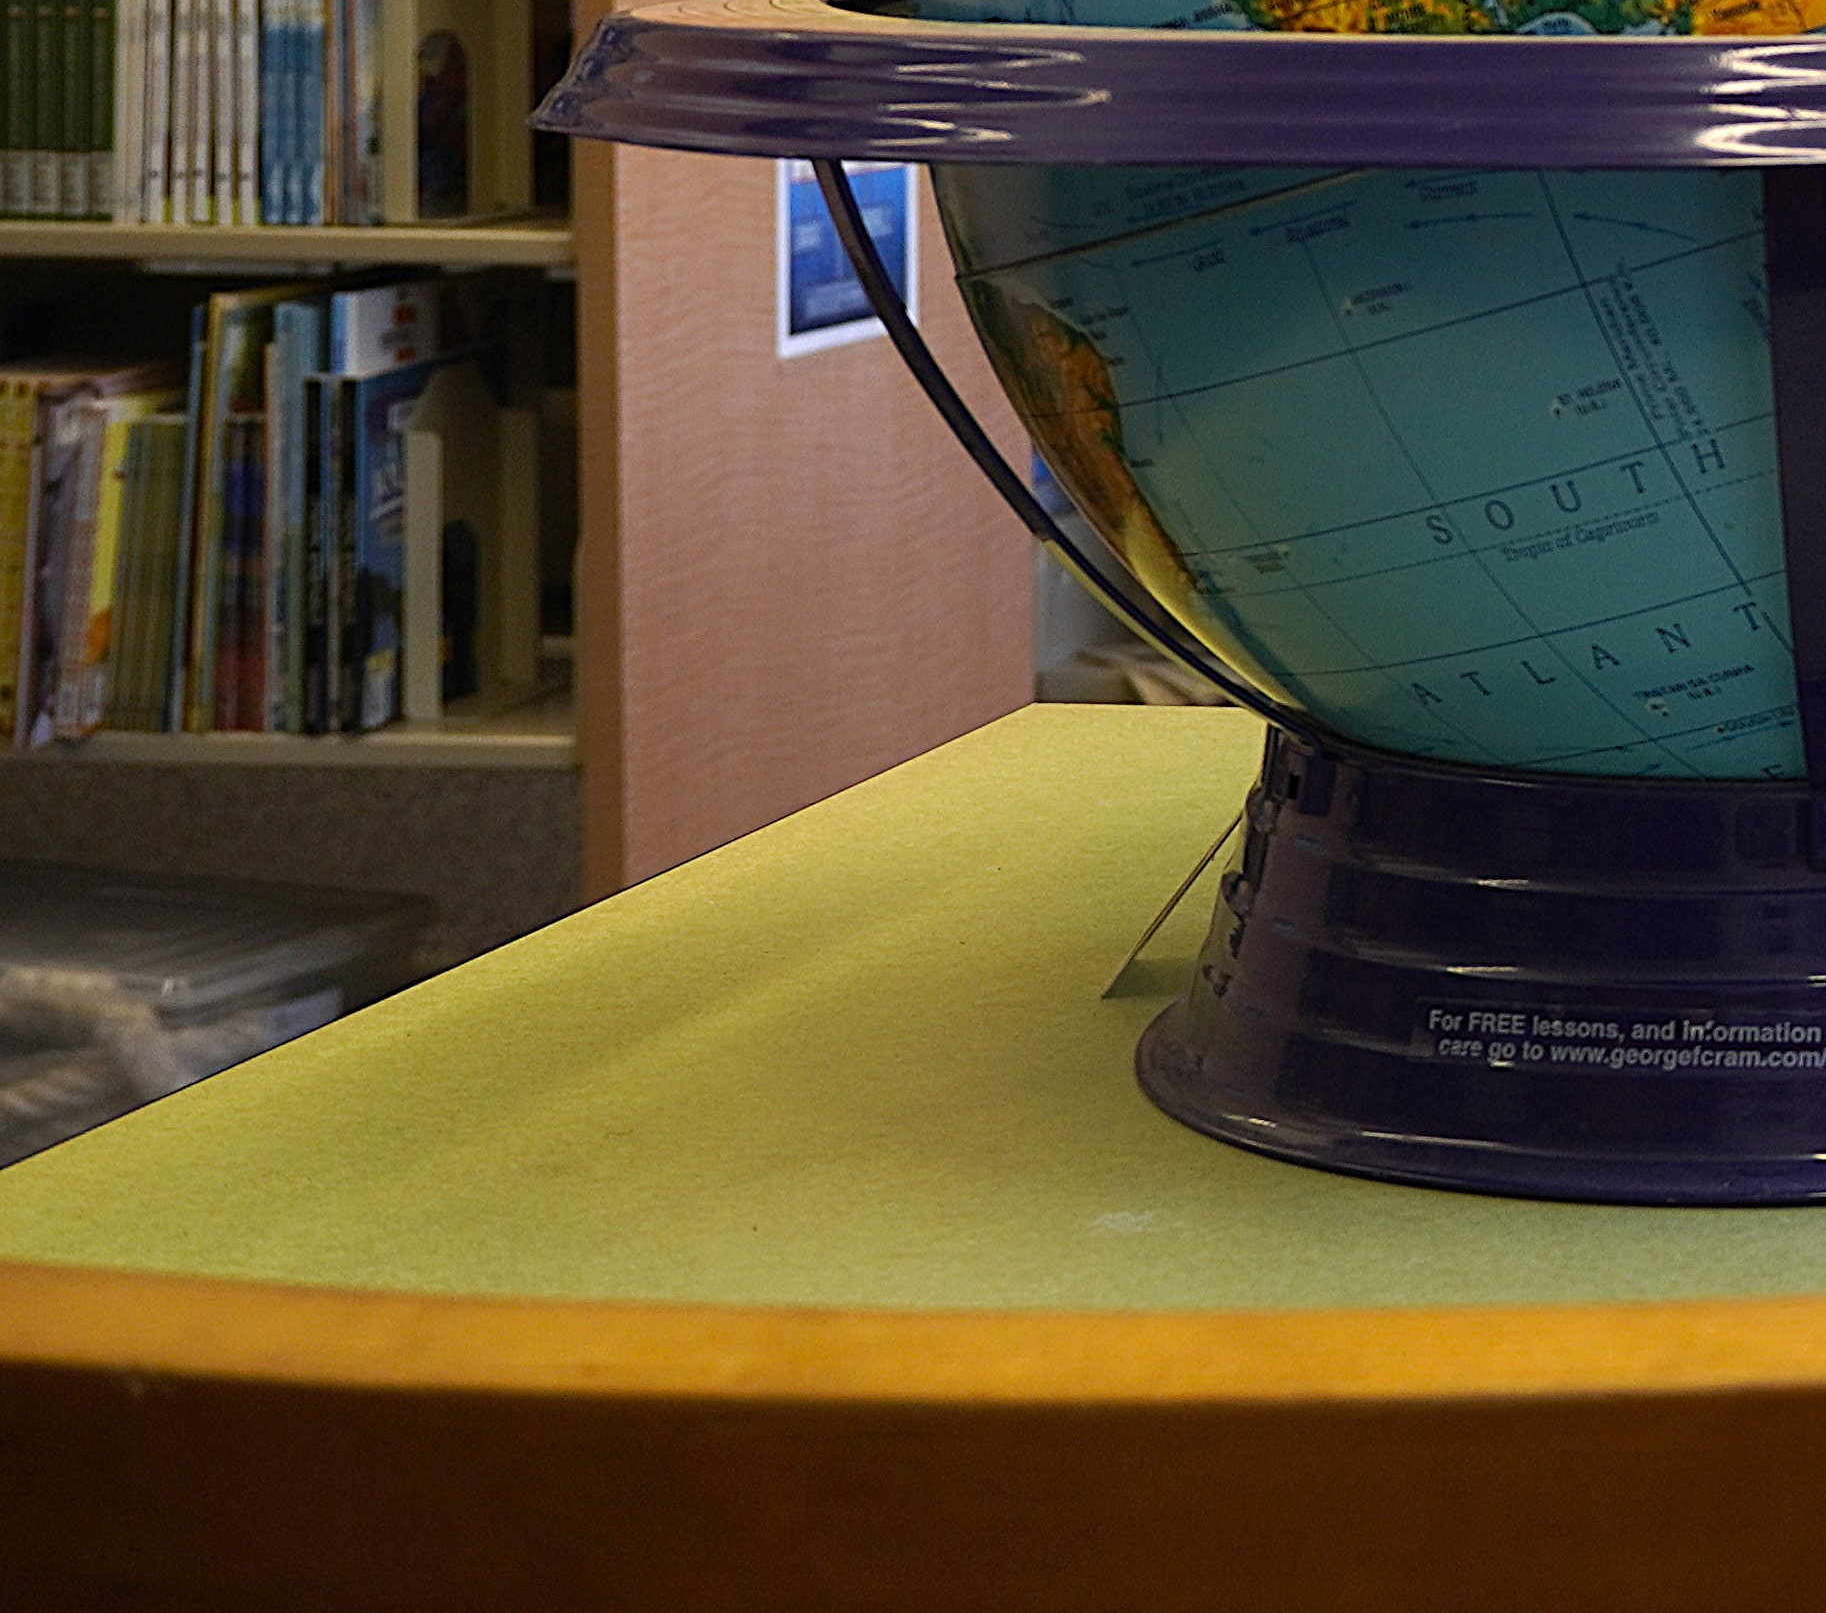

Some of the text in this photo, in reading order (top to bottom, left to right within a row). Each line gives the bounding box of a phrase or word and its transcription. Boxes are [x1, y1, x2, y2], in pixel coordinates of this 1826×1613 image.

[1424, 437, 1726, 547] SOUTH
[1428, 1008, 1463, 1032] For
[1468, 1010, 1527, 1036] FREE
[1532, 1015, 1627, 1043] lessons,
[1631, 1019, 1676, 1042] and
[1682, 1020, 1824, 1045] information
[1438, 1036, 1483, 1059] care
[1488, 1040, 1518, 1066] go
[1522, 1039, 1545, 1062] to
